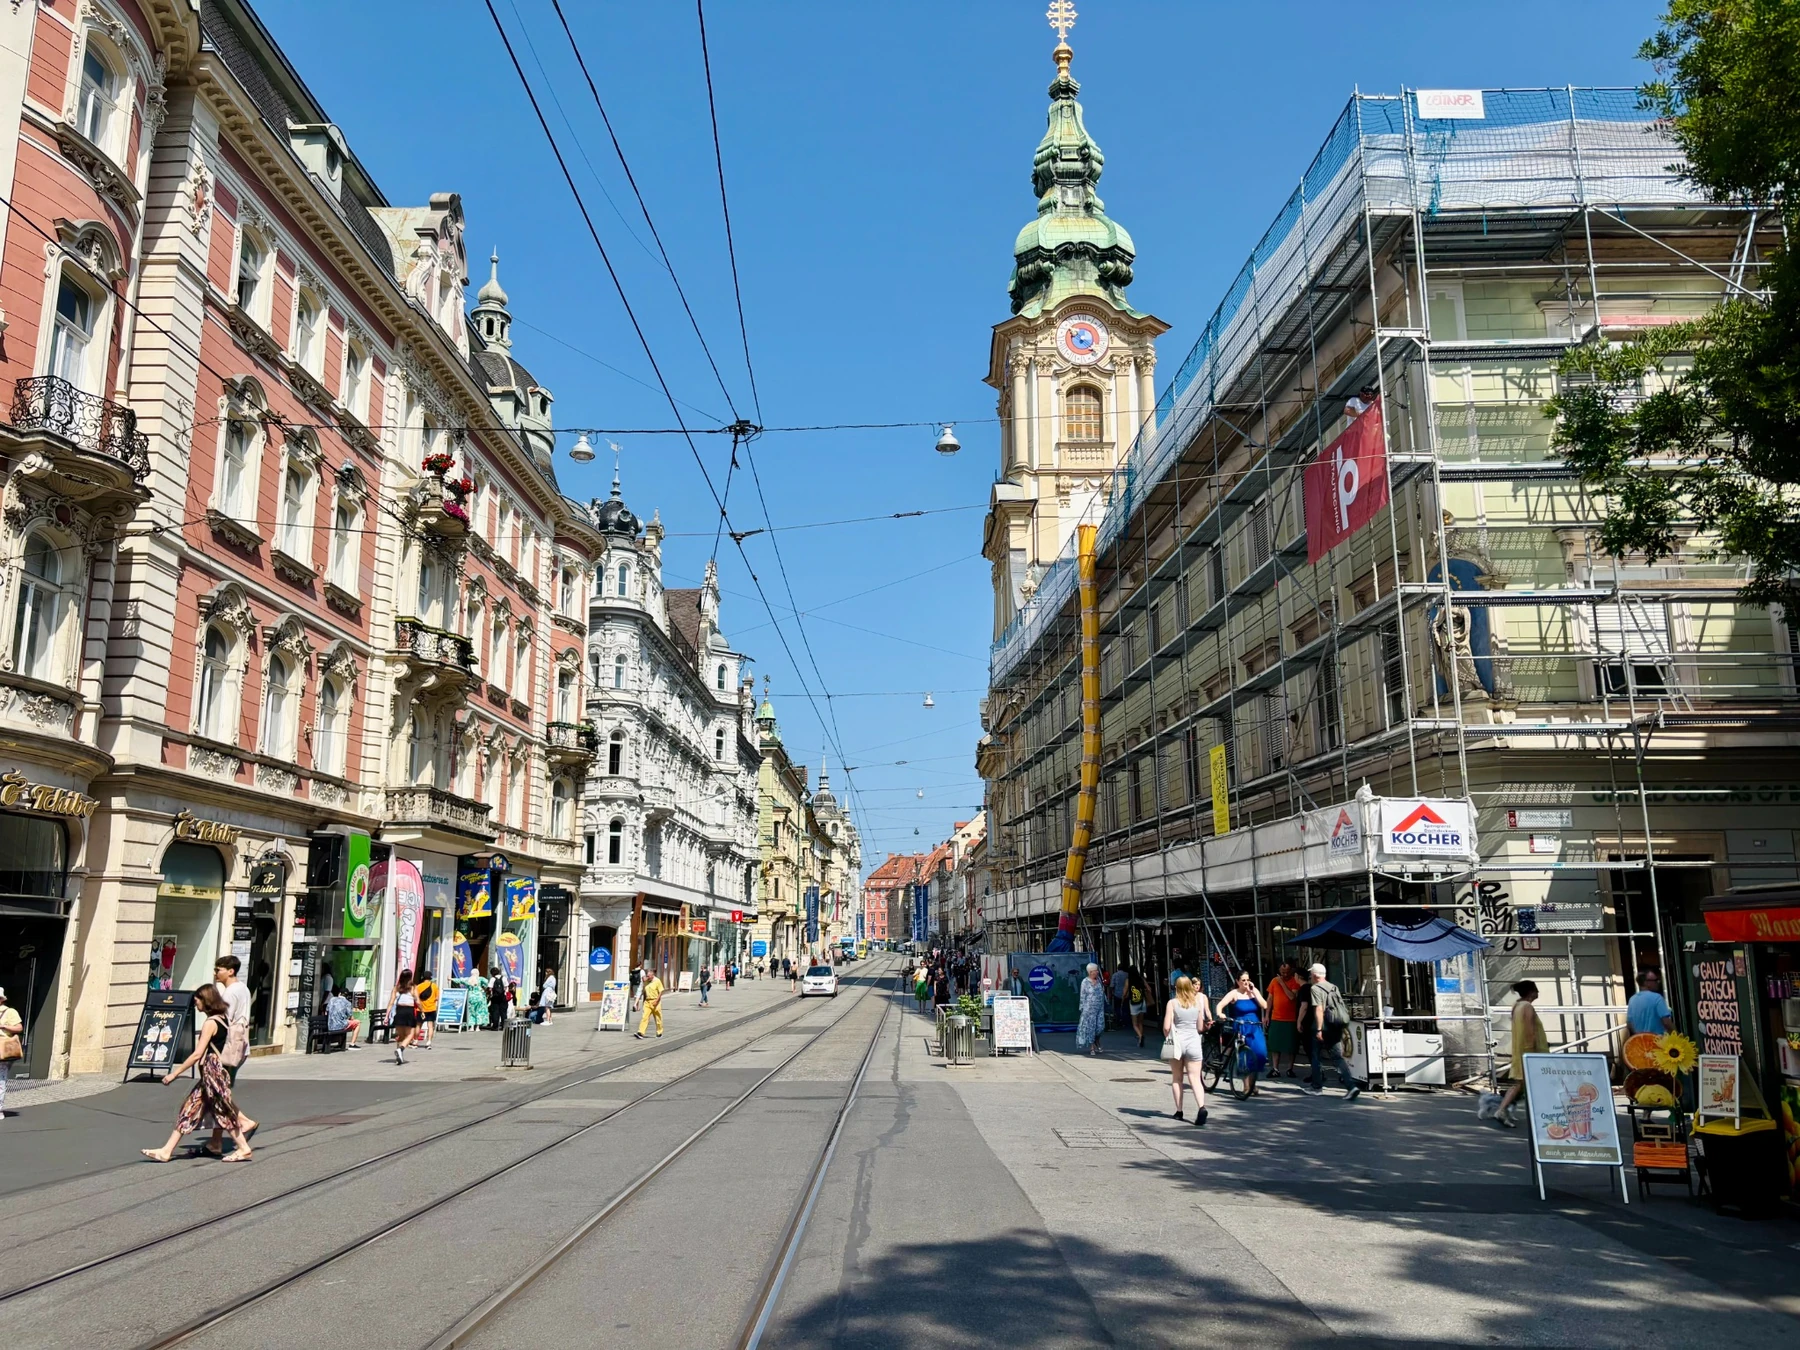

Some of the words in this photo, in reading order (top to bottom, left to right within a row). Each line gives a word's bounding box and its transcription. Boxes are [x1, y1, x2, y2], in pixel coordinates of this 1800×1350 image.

[31, 785, 100, 818] Tchibo
[1672, 785, 1753, 802] COLORS
[1757, 785, 1784, 802] OF
[196, 819, 242, 844] Tchibo
[1391, 832, 1461, 846] KOCHER
[1331, 833, 1358, 849] KOCHER
[251, 885, 280, 893] Tchibo
[303, 944, 317, 986] Italiana
[1700, 961, 1728, 979] GANZ
[1700, 981, 1736, 1000] FRISCH
[299, 992, 312, 1046] Gelateria
[1697, 1000, 1740, 1022] GEPRESST
[1706, 1022, 1741, 1041] ORANGE
[1704, 1038, 1743, 1056] KAROTTE
[1541, 1067, 1593, 1076] Maronessa
[1562, 1151, 1577, 1159] zum
